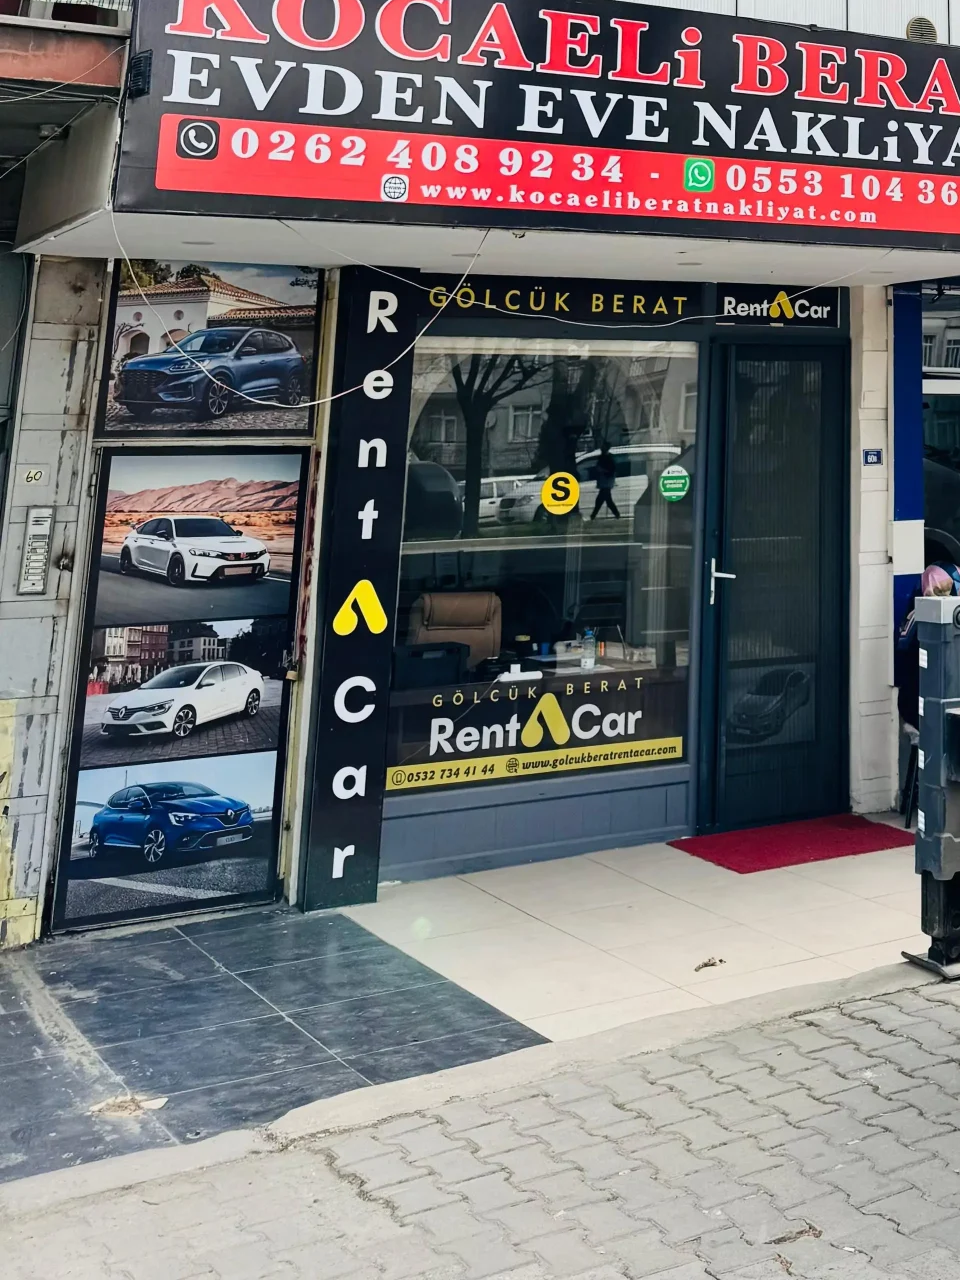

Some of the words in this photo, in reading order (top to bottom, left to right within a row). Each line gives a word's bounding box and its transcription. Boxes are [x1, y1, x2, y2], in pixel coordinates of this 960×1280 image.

[162, 49, 493, 128] EVDEN
[516, 84, 669, 142] EVE
[231, 127, 367, 167] 0262
[386, 139, 479, 173] 408
[499, 147, 553, 178] 92
[571, 153, 623, 182] 34
[726, 164, 823, 196] 0553
[840, 173, 903, 202] 104
[917, 179, 958, 206] 36
[420, 183, 877, 224] www.kocaeliberatnakliyat.com
[429, 282, 571, 313] GÖLCÜK
[591, 293, 688, 316] BERAT
[26, 471, 42, 483] 60
[551, 476, 571, 502] S
[432, 685, 537, 707] GÖLCÜK
[566, 677, 643, 695] BERAT
[522, 745, 677, 769] www.golcukberatrentacar.com
[407, 770, 435, 782] 0532
[440, 767, 460, 779] 734
[464, 766, 476, 777] 41
[481, 764, 495, 775] 44
